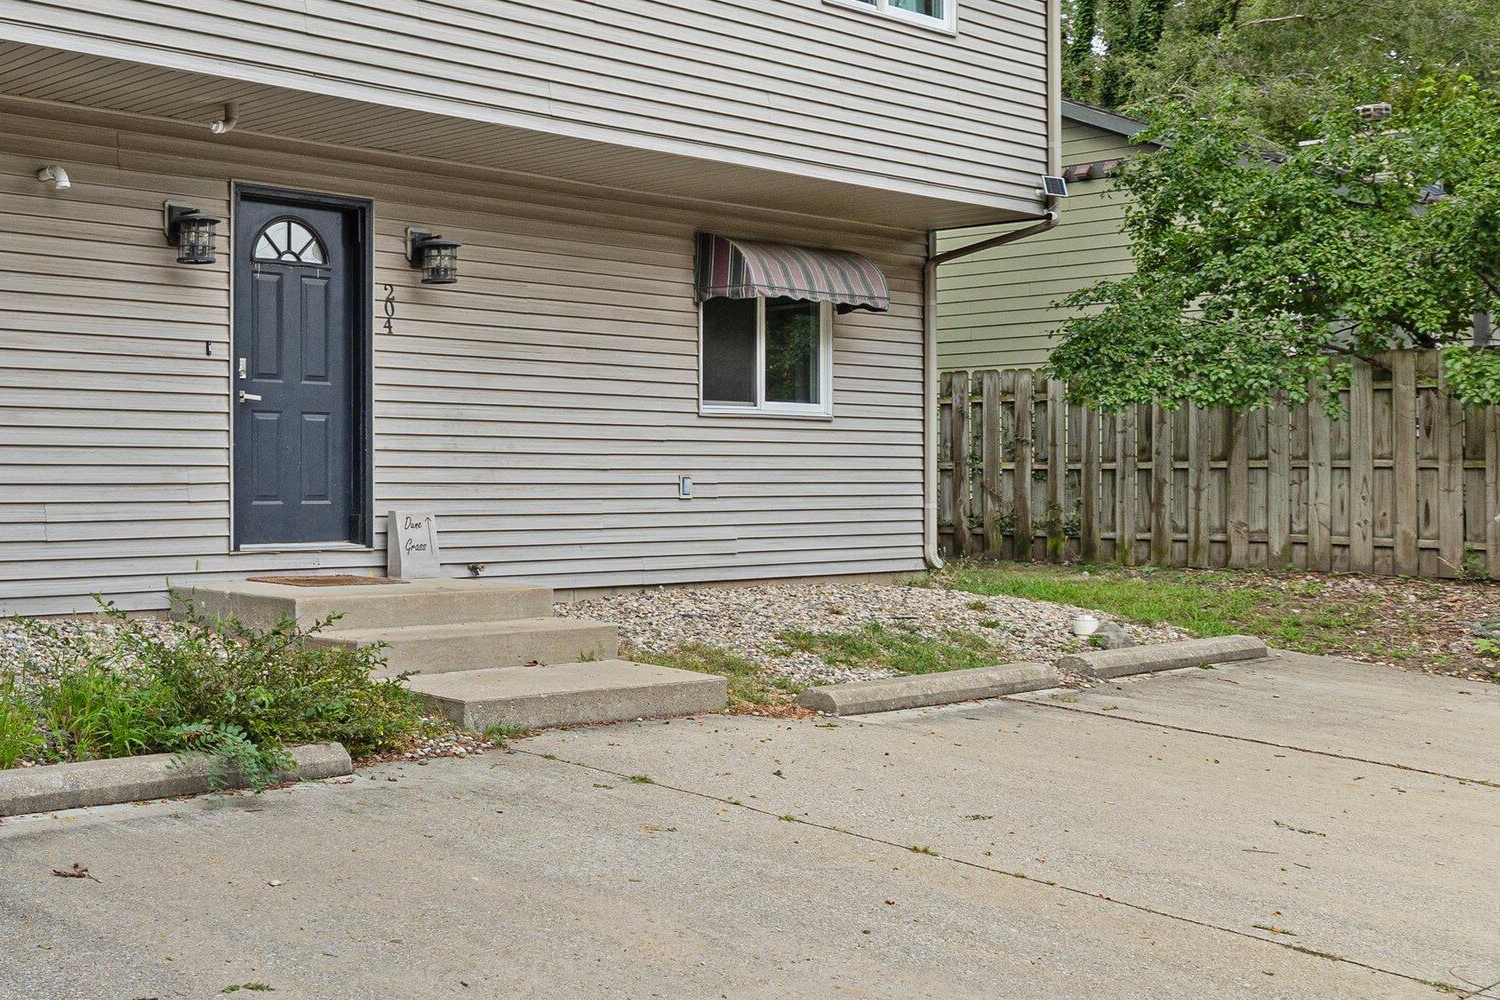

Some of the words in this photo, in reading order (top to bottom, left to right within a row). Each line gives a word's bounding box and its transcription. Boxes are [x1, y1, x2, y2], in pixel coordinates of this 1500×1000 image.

[383, 284, 395, 335] 204
[404, 516, 422, 530] Dune
[405, 538, 427, 555] Grass
